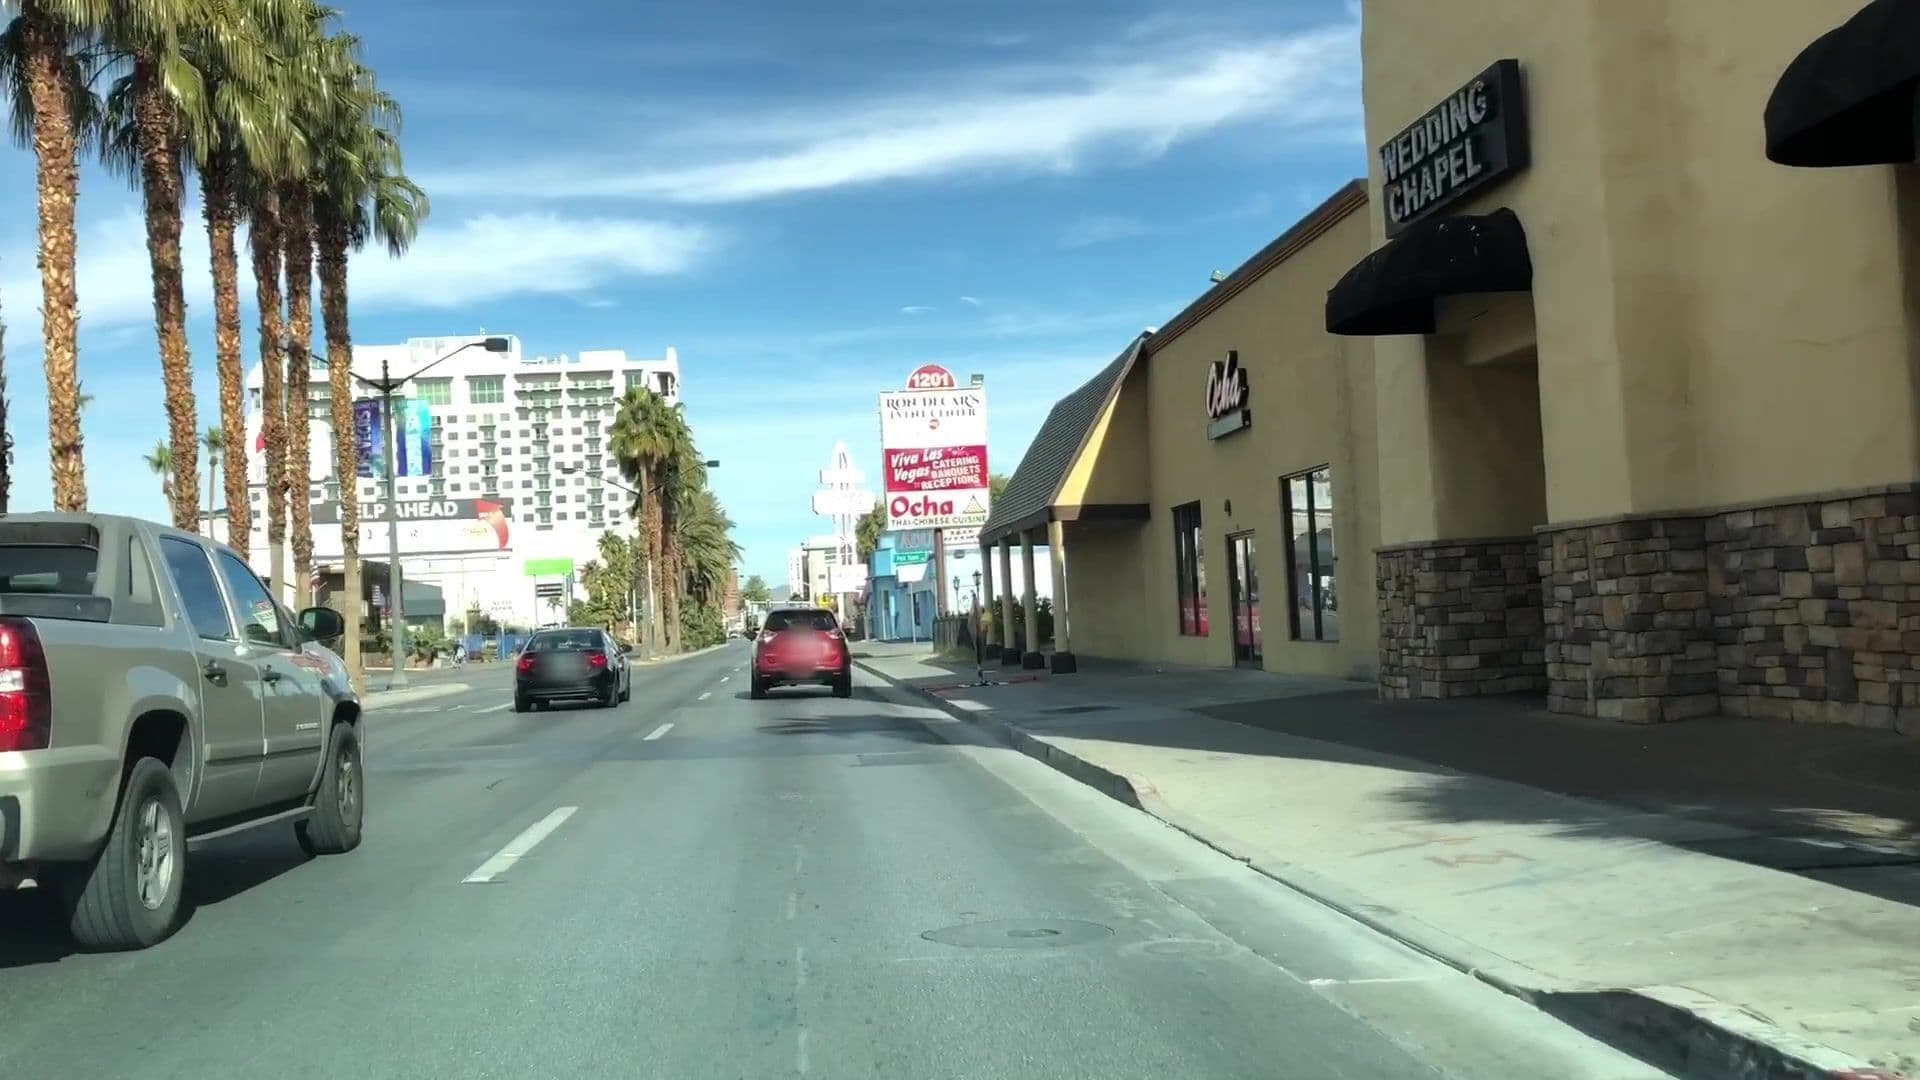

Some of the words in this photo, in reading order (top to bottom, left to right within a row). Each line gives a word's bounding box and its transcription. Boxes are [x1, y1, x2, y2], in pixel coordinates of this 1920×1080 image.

[1379, 80, 1488, 185] WEDDING
[1388, 138, 1482, 223] CHAPEL
[912, 373, 949, 387] 1201
[1205, 350, 1243, 419] Ocha
[886, 397, 916, 410] RON
[890, 453, 919, 468] Viva
[922, 448, 943, 462] Las
[932, 455, 979, 470] CATERING
[893, 466, 930, 484] Vegas
[930, 465, 981, 479] BANQUETS
[921, 474, 980, 490] RECEPTIONS
[395, 501, 458, 518] AHEAD
[890, 495, 953, 518] Ocha
[952, 515, 987, 524] CUISINE
